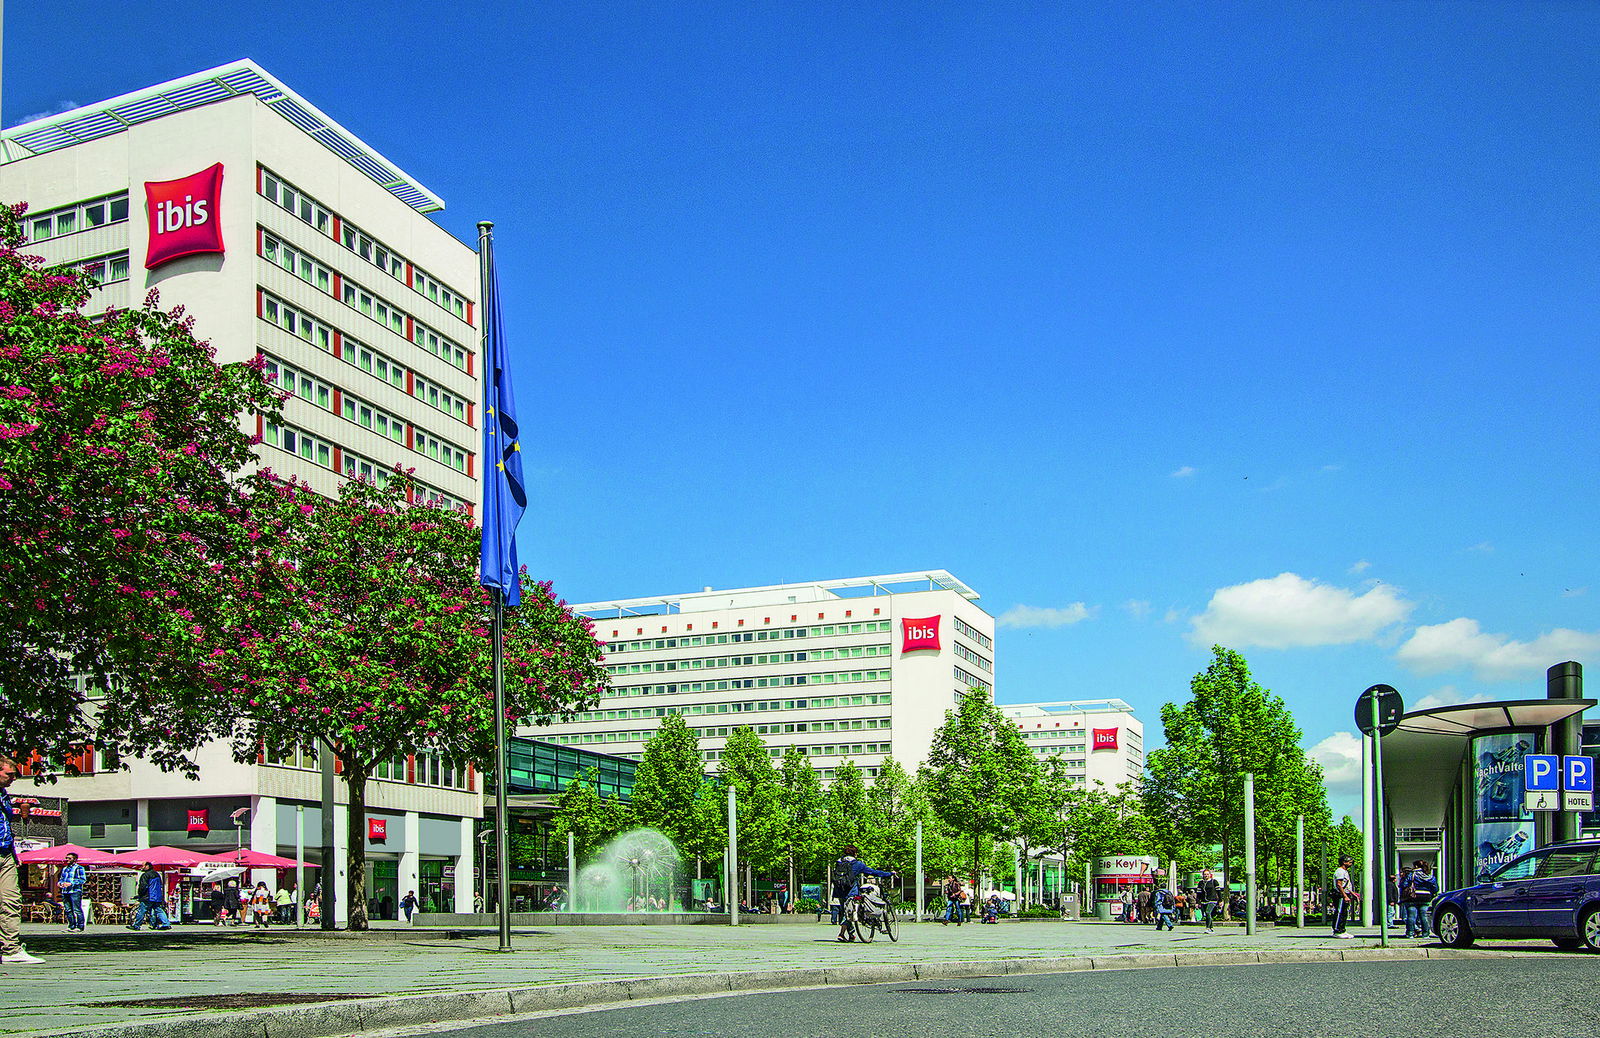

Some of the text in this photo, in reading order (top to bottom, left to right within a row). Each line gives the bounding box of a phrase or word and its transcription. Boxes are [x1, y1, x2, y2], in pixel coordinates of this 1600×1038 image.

[157, 195, 208, 234] ibis
[908, 625, 935, 640] ibis
[1096, 733, 1115, 743] ibis
[1532, 759, 1551, 786] P
[1570, 760, 1586, 787] P
[1567, 798, 1590, 806] HOTEL
[190, 815, 204, 825] ibis
[373, 824, 385, 833] ibis
[1098, 859, 1138, 869] Eis Keyl
